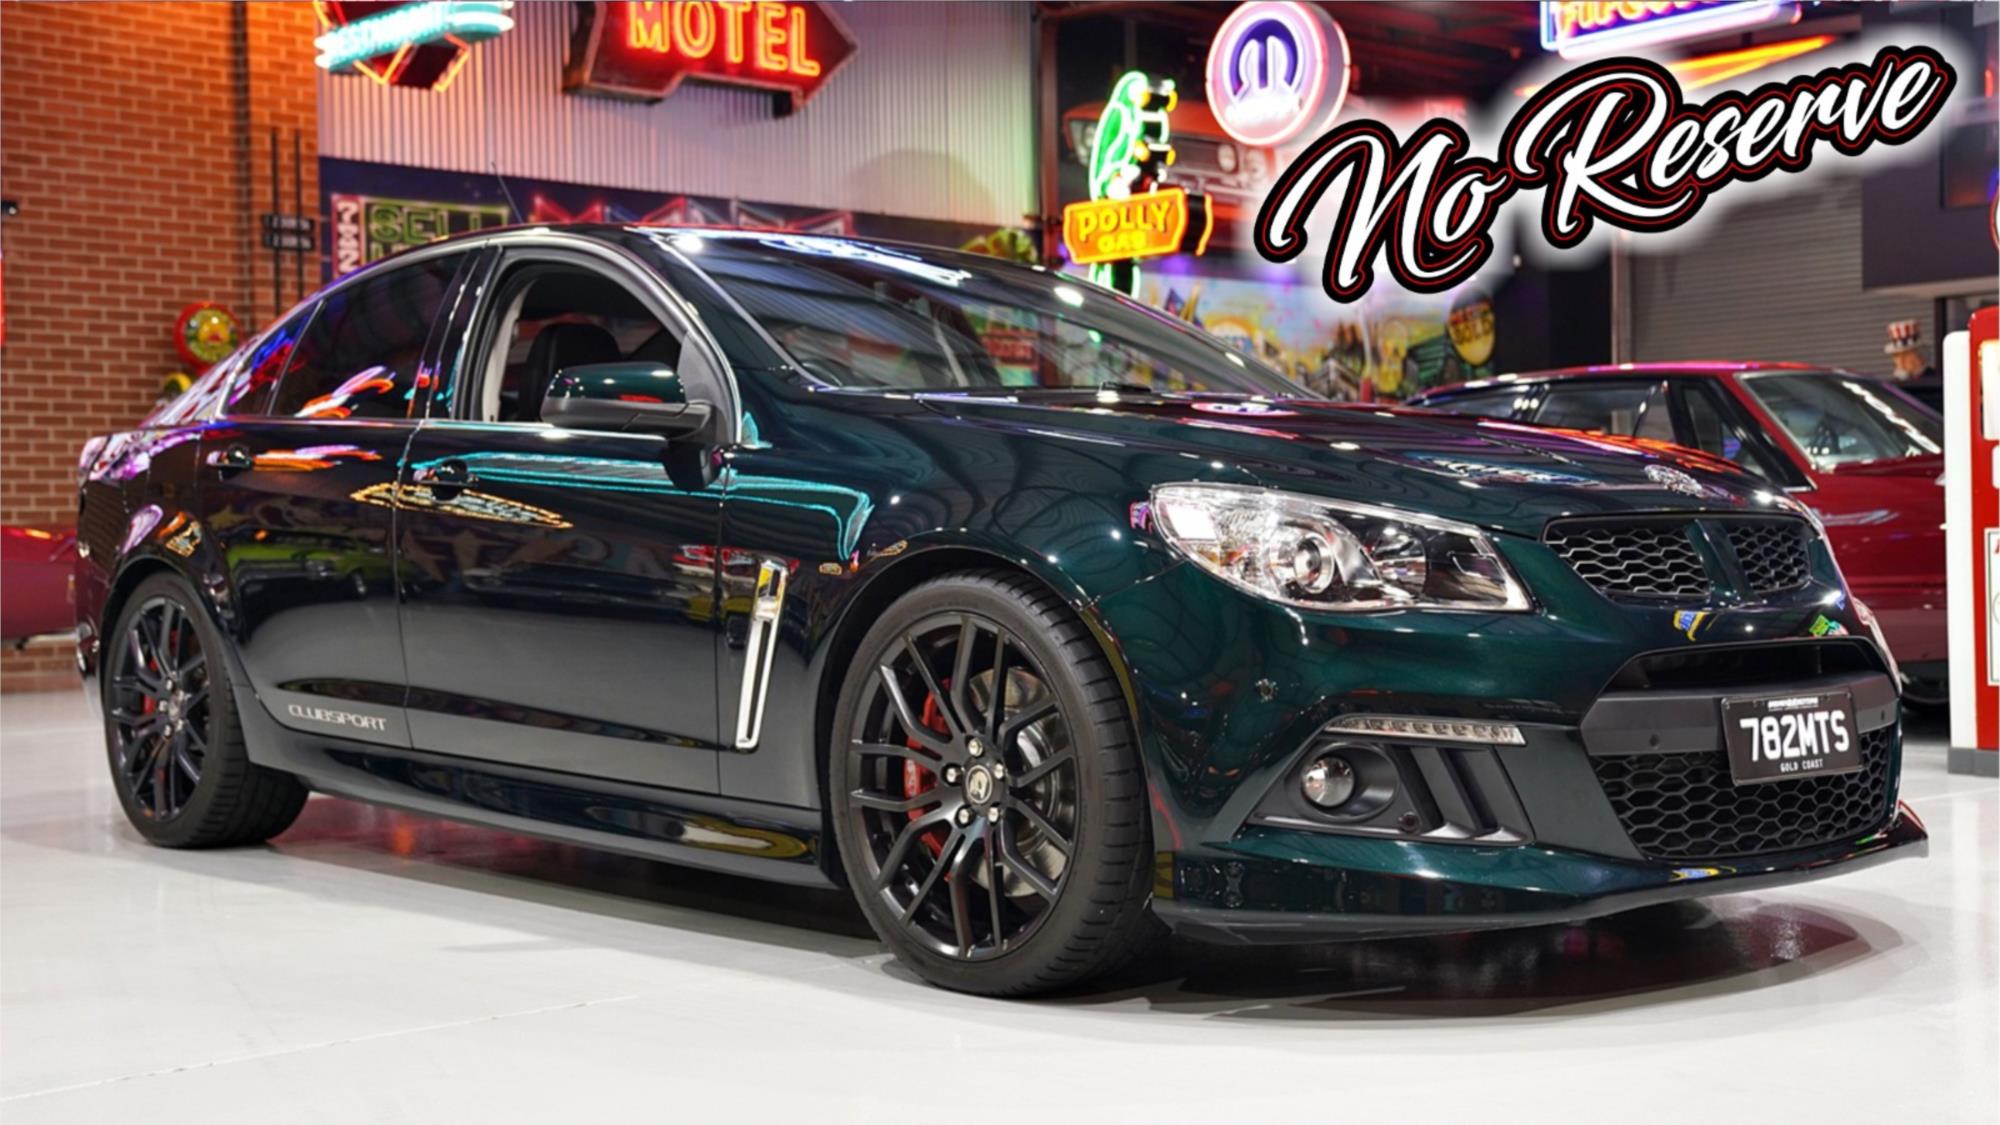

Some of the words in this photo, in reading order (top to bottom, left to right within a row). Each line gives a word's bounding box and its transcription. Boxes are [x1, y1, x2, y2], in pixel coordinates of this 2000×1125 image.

[627, 1, 821, 77] MOTEL
[1077, 200, 1171, 242] POLLY
[287, 704, 387, 732] CLUBSPORT
[1739, 709, 1851, 763] 782MTS
[1780, 761, 1799, 773] GOLD
[1801, 758, 1824, 771] COAST
